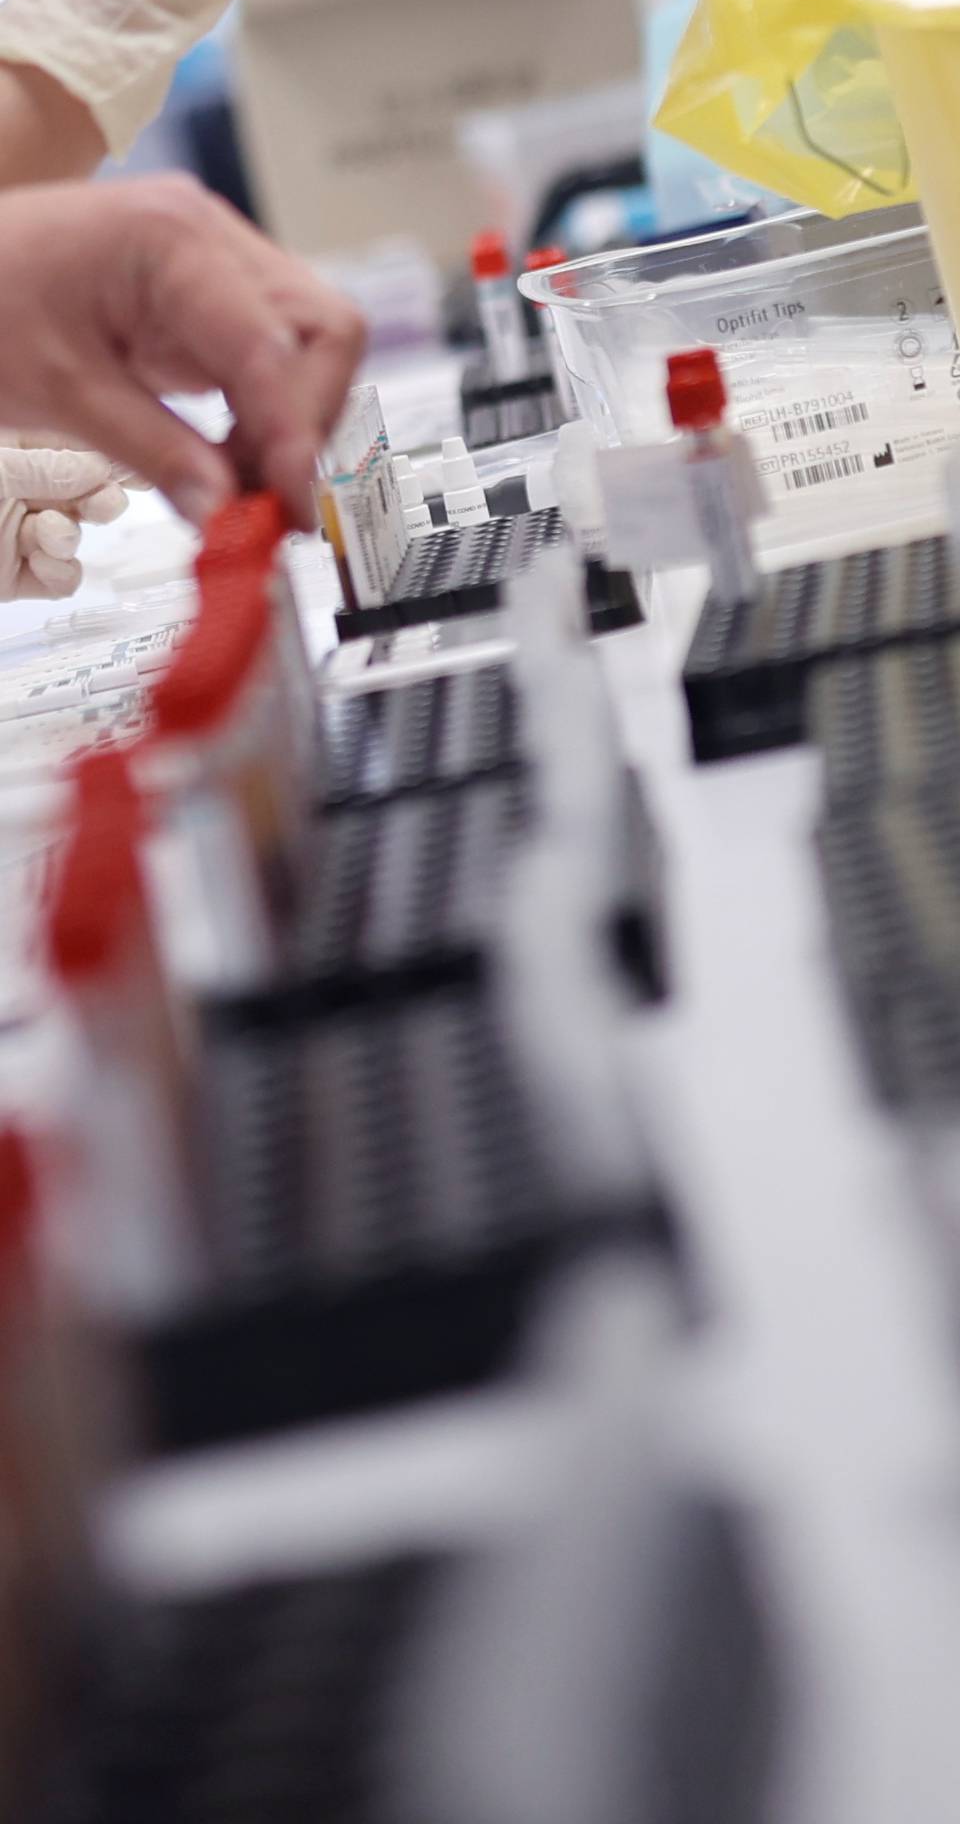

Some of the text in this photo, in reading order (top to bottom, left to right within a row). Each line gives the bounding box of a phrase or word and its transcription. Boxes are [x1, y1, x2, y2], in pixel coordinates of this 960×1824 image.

[716, 300, 806, 335] Optifit Tips
[743, 413, 764, 426] REF
